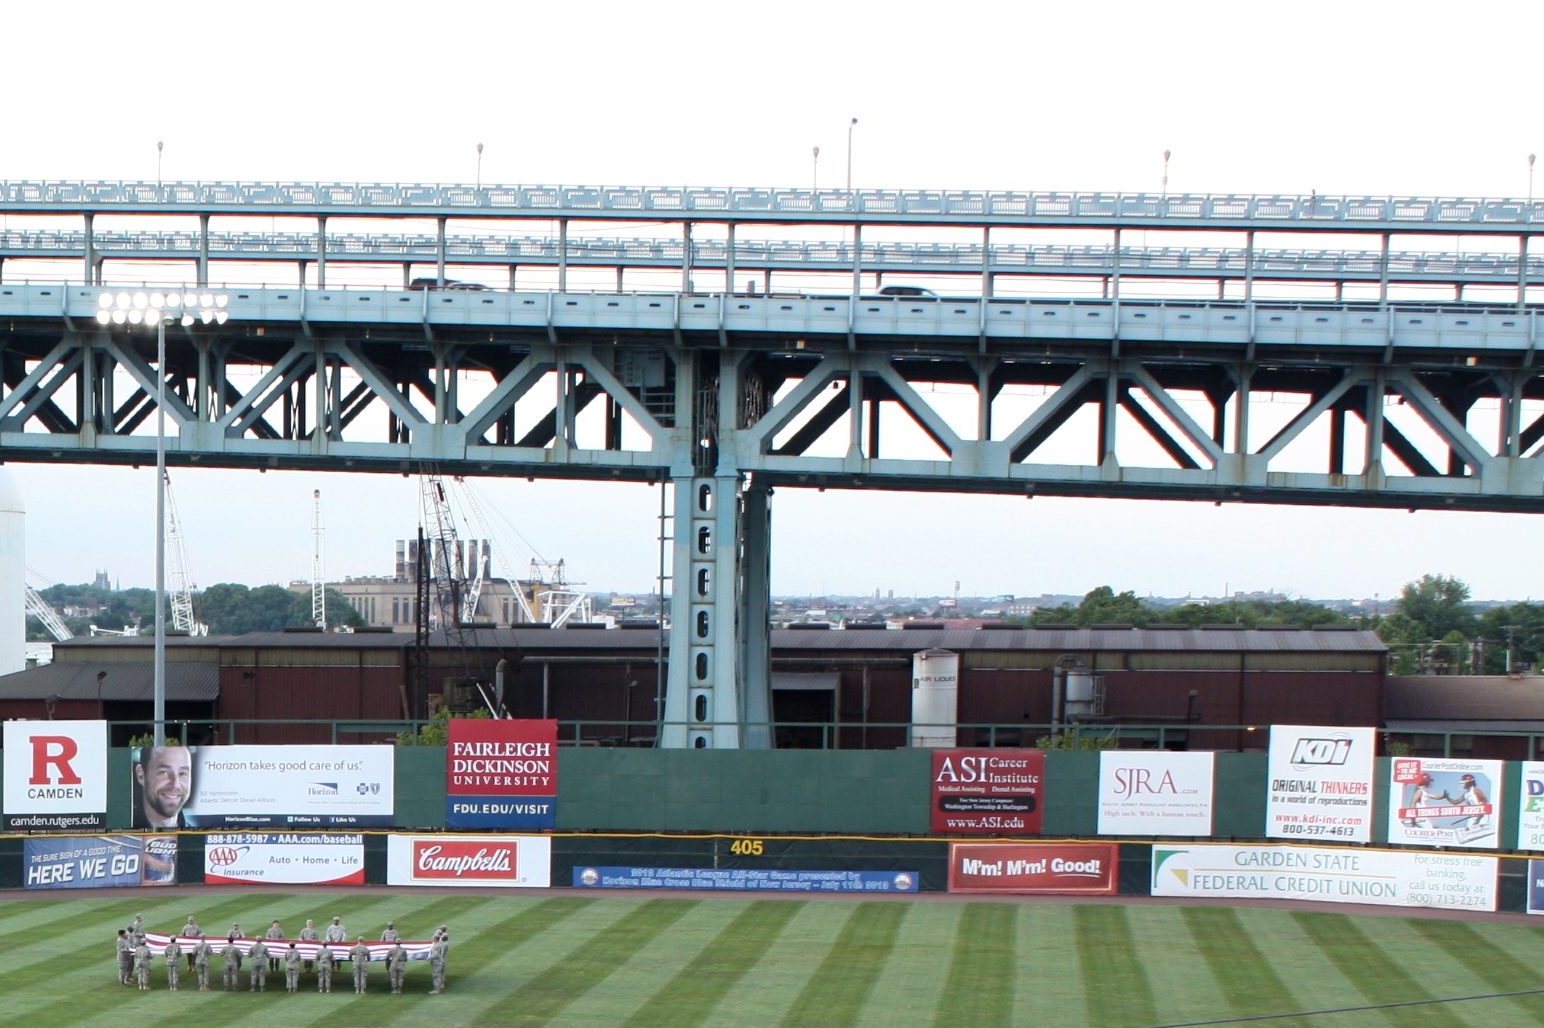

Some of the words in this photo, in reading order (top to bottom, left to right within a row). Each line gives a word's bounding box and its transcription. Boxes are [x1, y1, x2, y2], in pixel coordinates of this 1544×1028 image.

[453, 742, 550, 757] FAIRLEIGH
[29, 735, 81, 785] R
[249, 760, 276, 771] takes
[279, 761, 306, 773] good
[309, 762, 331, 771] care
[334, 760, 344, 771] of
[989, 758, 1028, 768] Career
[453, 760, 549, 774] DICKINSON
[936, 757, 988, 783] ASI
[454, 776, 550, 786] UNIVERSITY
[989, 773, 1039, 783] Institute
[1113, 768, 1178, 801] SJRA
[27, 788, 84, 799] CAMDEN
[308, 787, 338, 796] Horizon
[1272, 780, 1317, 793] ORIGINAL
[1321, 781, 1368, 795] THINKERS
[454, 804, 549, 815] FDU.EDU/VISIT
[1405, 809, 1417, 818] ALL
[1418, 808, 1439, 817] THINGS
[1441, 807, 1461, 816] SOUTH
[10, 815, 99, 828] camden.rutgers.edu
[947, 817, 1024, 828] www.ASI.edu
[1275, 814, 1362, 826] www.kdi-inc.com
[1282, 825, 1354, 836] 800-537-4613
[207, 835, 268, 844] 888-878-5987
[278, 834, 363, 844] AAA.com/baseball
[145, 847, 178, 855] LIGHT
[730, 839, 764, 855] 405
[211, 848, 237, 864] AAA
[269, 856, 291, 864] Auto
[303, 856, 329, 865] Home
[341, 856, 358, 865] Life
[418, 845, 511, 876] Campbell's
[1234, 851, 1307, 868] GARDEN
[1312, 854, 1360, 870] STATE
[1414, 854, 1428, 865] For
[1431, 856, 1460, 866] stress
[1462, 857, 1483, 867] free
[27, 861, 74, 885] HERE
[79, 858, 107, 879] WE
[111, 854, 139, 876] GO
[223, 868, 264, 876] Insurance
[1051, 858, 1101, 873] Good!
[1193, 875, 1269, 890] FEDERAL
[1274, 876, 1333, 893] CREDIT
[1338, 879, 1396, 897] UNION
[1409, 880, 1425, 890] call
[1428, 882, 1439, 890] us
[1443, 881, 1470, 894] today
[1473, 884, 1484, 893] at
[1407, 893, 1433, 905] (800)
[1437, 894, 1486, 906] 713-2274
